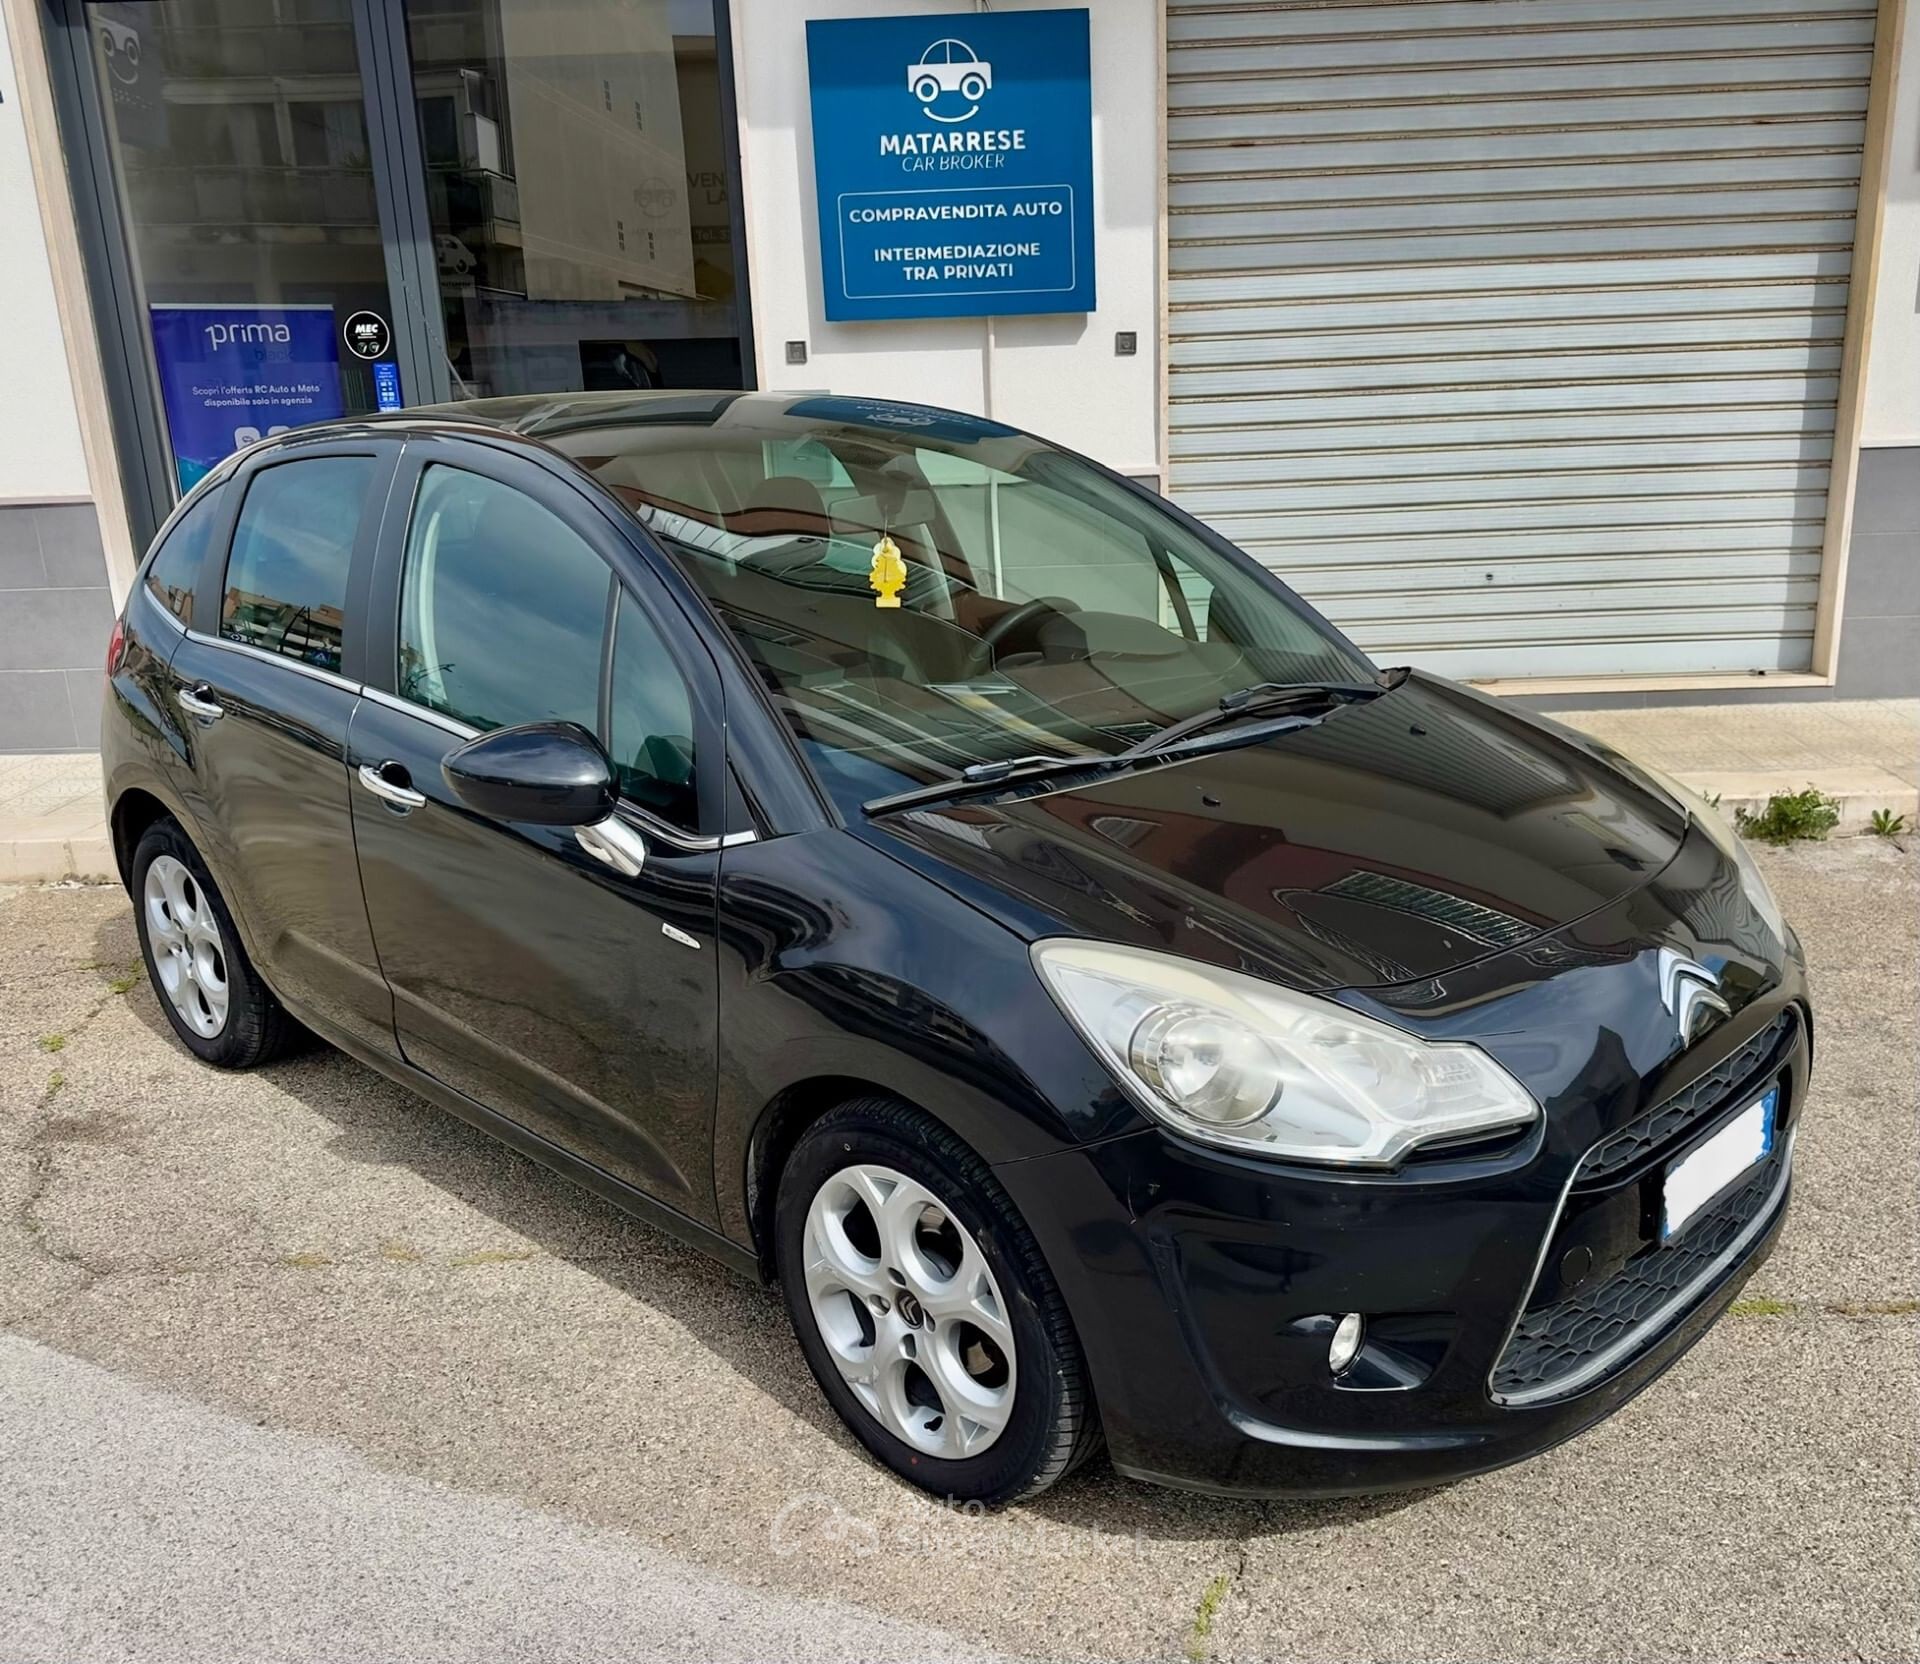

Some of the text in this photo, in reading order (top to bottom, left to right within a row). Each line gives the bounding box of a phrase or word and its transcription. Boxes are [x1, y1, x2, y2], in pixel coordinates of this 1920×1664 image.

[880, 129, 1026, 156] MATARRESE
[902, 153, 1006, 172] CAR BROKER
[849, 201, 1063, 223] COMPRAVENDITA AUTO
[874, 242, 1041, 262] INTERMEDIAZIONE
[902, 263, 1013, 281] TRA PRIVATI
[204, 323, 291, 352] prima
[355, 324, 379, 333] MEC
[192, 386, 220, 396] Scopri
[221, 386, 253, 395] l'offerta
[254, 385, 268, 393] RC
[269, 385, 289, 393] Auto
[298, 384, 321, 393] Moto
[204, 396, 313, 408] disponibile solo in agenzia
